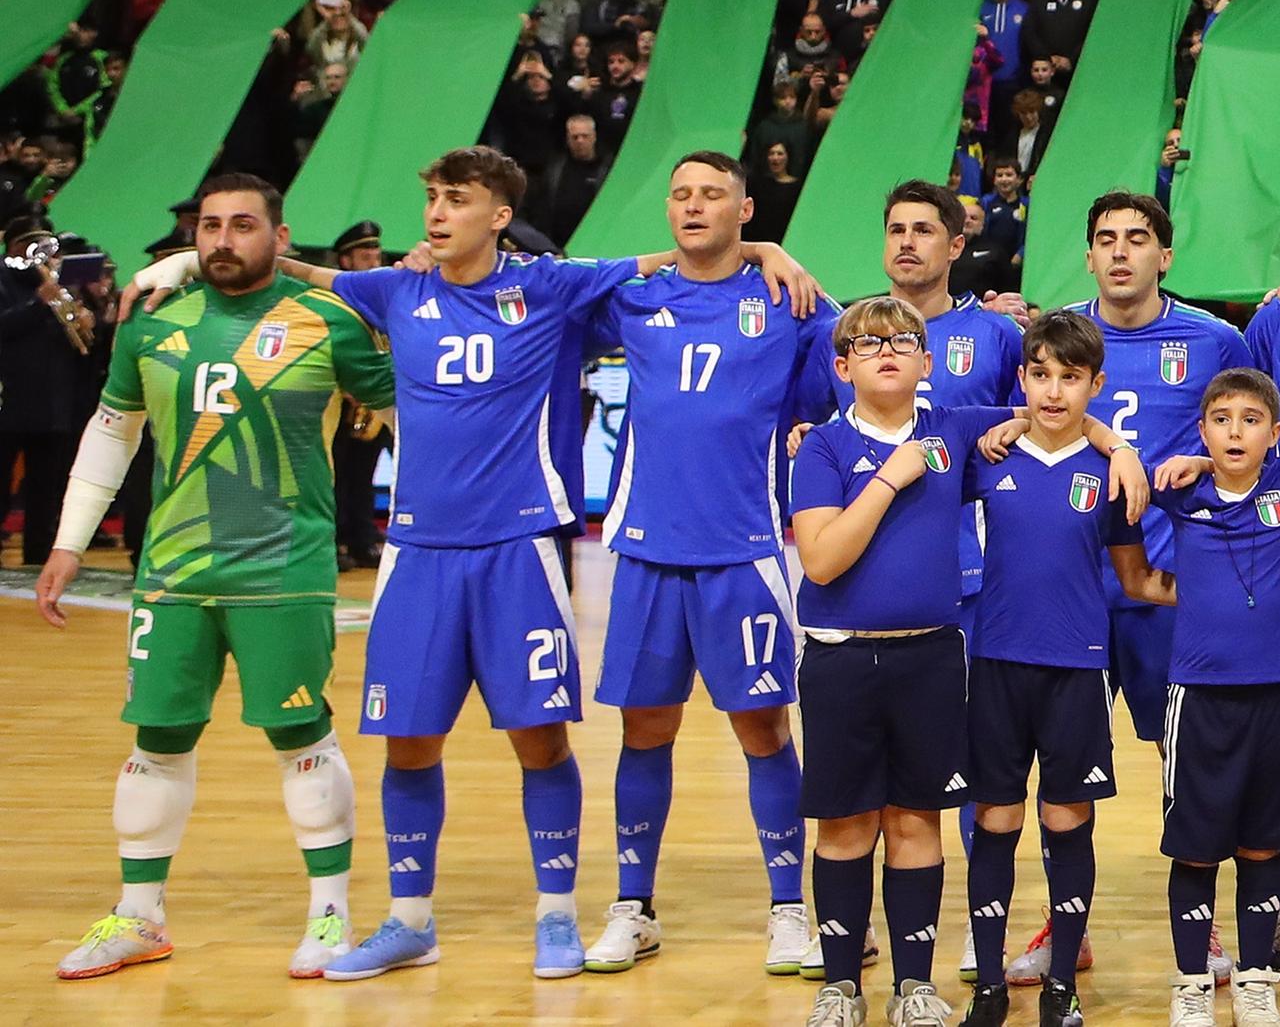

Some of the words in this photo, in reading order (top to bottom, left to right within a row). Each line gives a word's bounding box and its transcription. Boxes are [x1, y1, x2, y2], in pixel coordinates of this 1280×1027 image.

[741, 304, 762, 312] ITALIA
[950, 344, 973, 352] ITALIA
[1164, 350, 1185, 358] ITALIA
[436, 333, 494, 384] 20
[679, 343, 720, 391] 17
[193, 362, 238, 413] 12
[1112, 390, 1138, 440] 2
[1076, 476, 1099, 487] ITALIA
[1258, 493, 1280, 504] ITALIA
[741, 613, 778, 666] 17
[526, 629, 567, 681] 20
[534, 826, 578, 839] ITALIA
[758, 826, 798, 840] ITALIA
